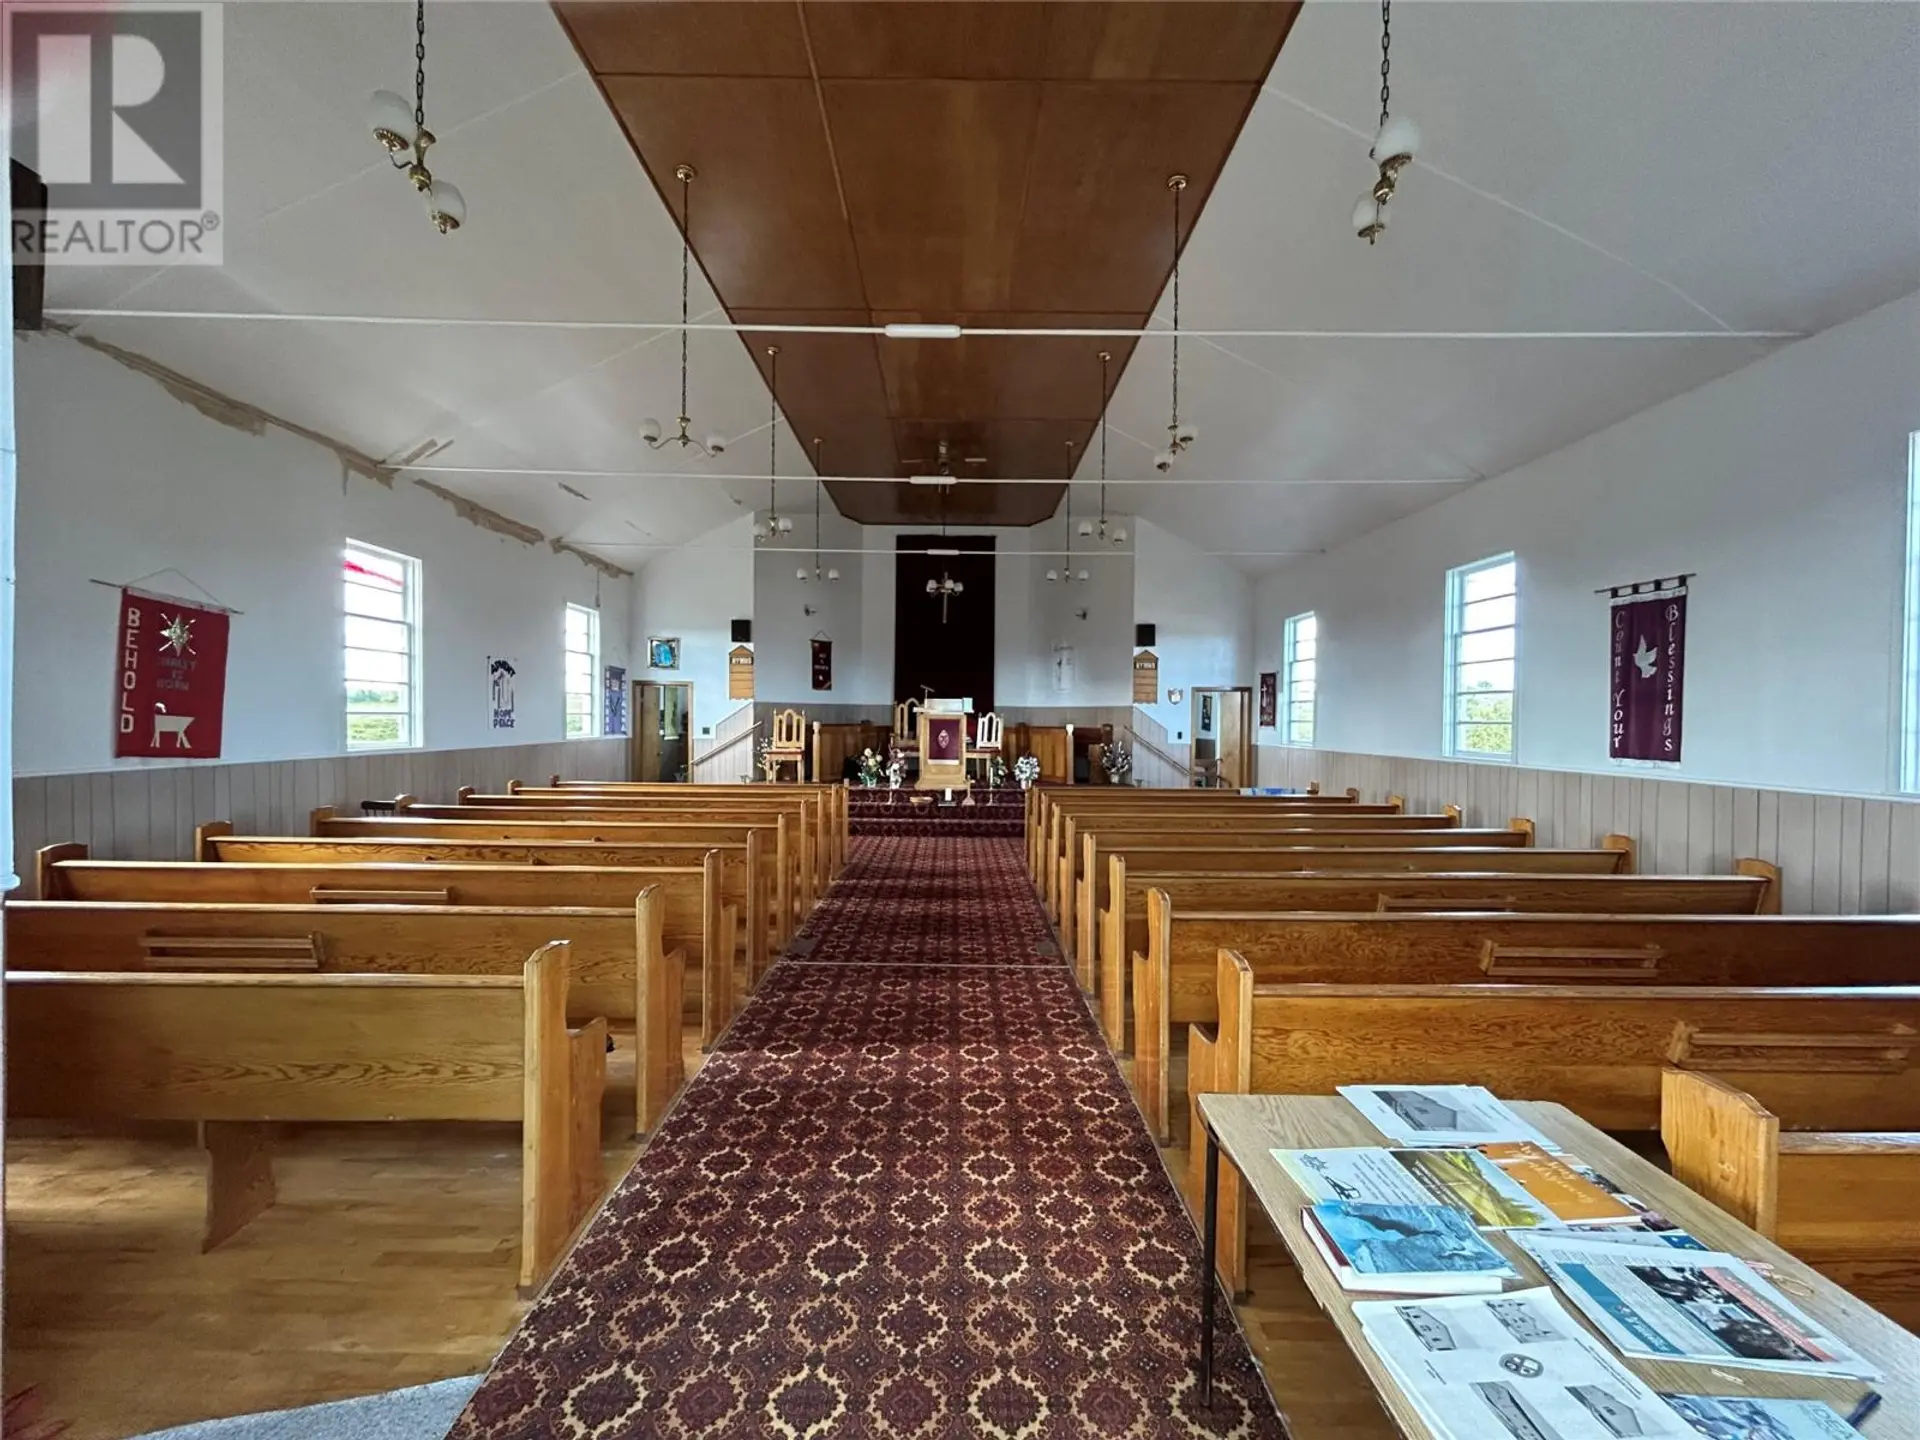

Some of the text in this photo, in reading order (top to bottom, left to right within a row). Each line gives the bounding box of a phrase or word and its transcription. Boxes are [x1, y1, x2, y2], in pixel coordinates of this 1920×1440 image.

[120, 608, 142, 734] BEHOLD
[493, 708, 513, 719] HOPE
[493, 718, 516, 729] PEACE
[1613, 610, 1627, 750] Count Your
[1662, 604, 1680, 752] Blessings
